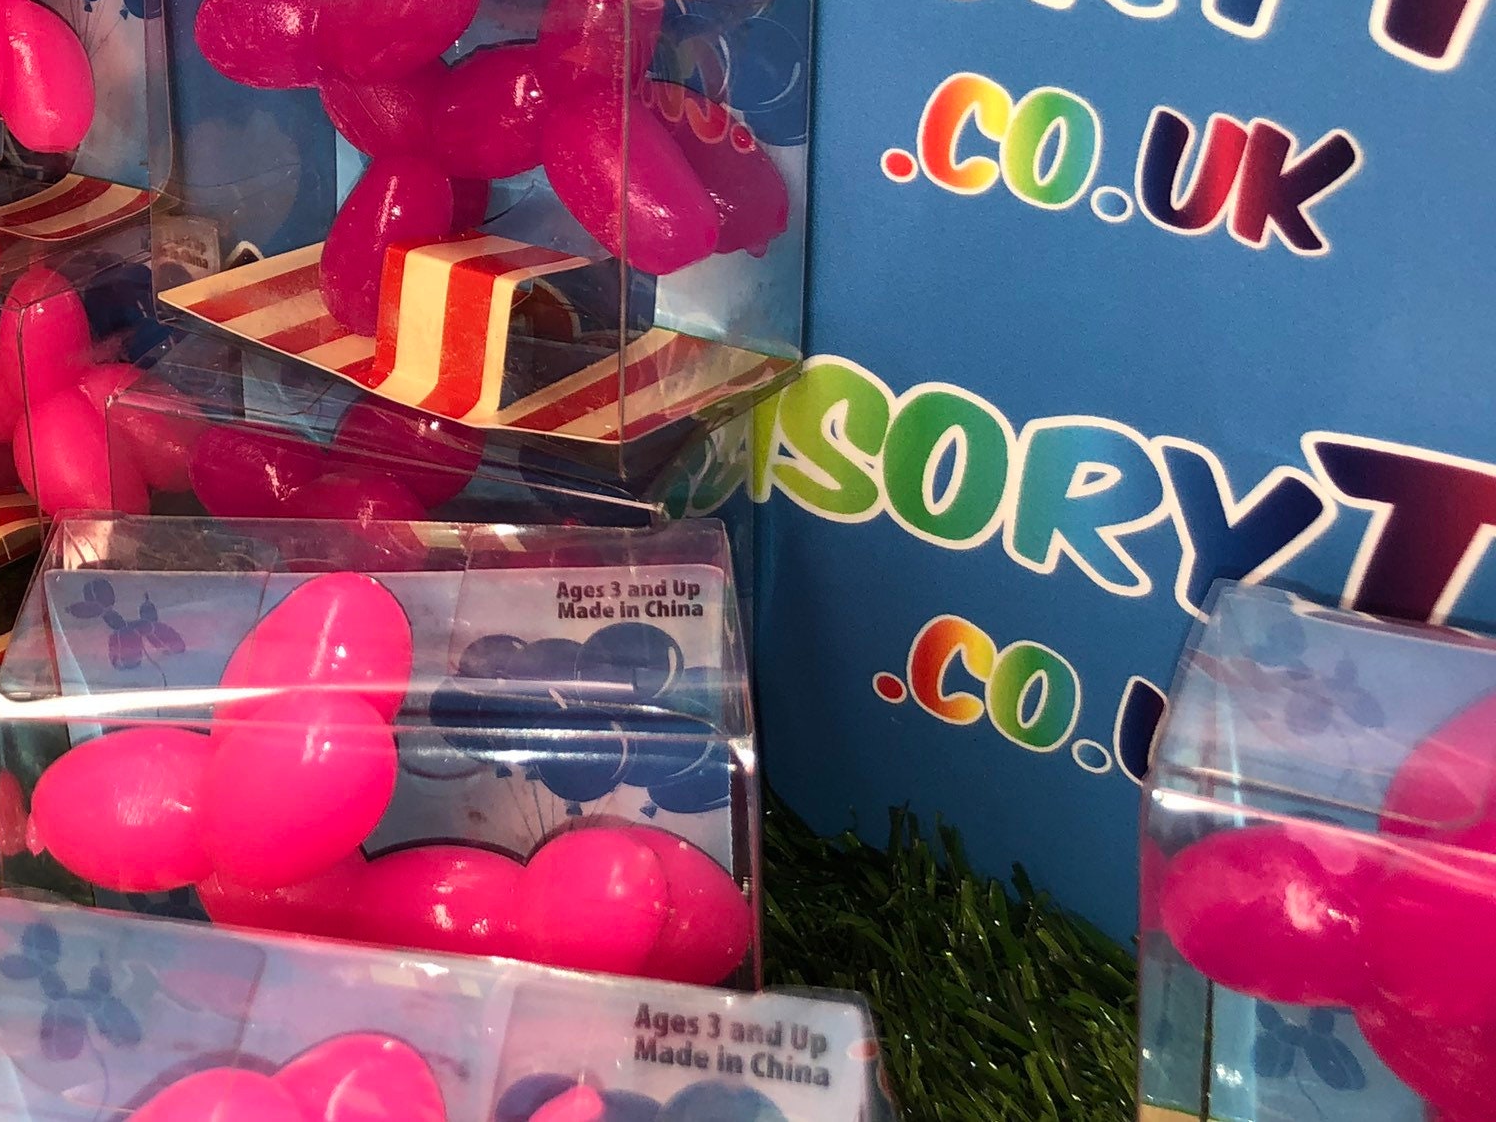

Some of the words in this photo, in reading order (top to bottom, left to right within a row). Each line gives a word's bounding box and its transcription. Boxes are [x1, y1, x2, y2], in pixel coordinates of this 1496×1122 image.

[881, 71, 1362, 257] .CO.UK
[556, 581, 604, 602] Ages
[610, 580, 622, 597] 3
[627, 579, 667, 597] and
[673, 579, 701, 601] Up
[557, 601, 615, 619] Made
[620, 600, 640, 618] in
[645, 599, 704, 617] China
[633, 1002, 699, 1037] Ages
[707, 1011, 722, 1039] 3
[729, 1020, 783, 1047] and
[790, 1022, 828, 1059] Up
[634, 1034, 710, 1069] Made
[717, 1044, 744, 1075] in
[750, 1050, 831, 1087] China
